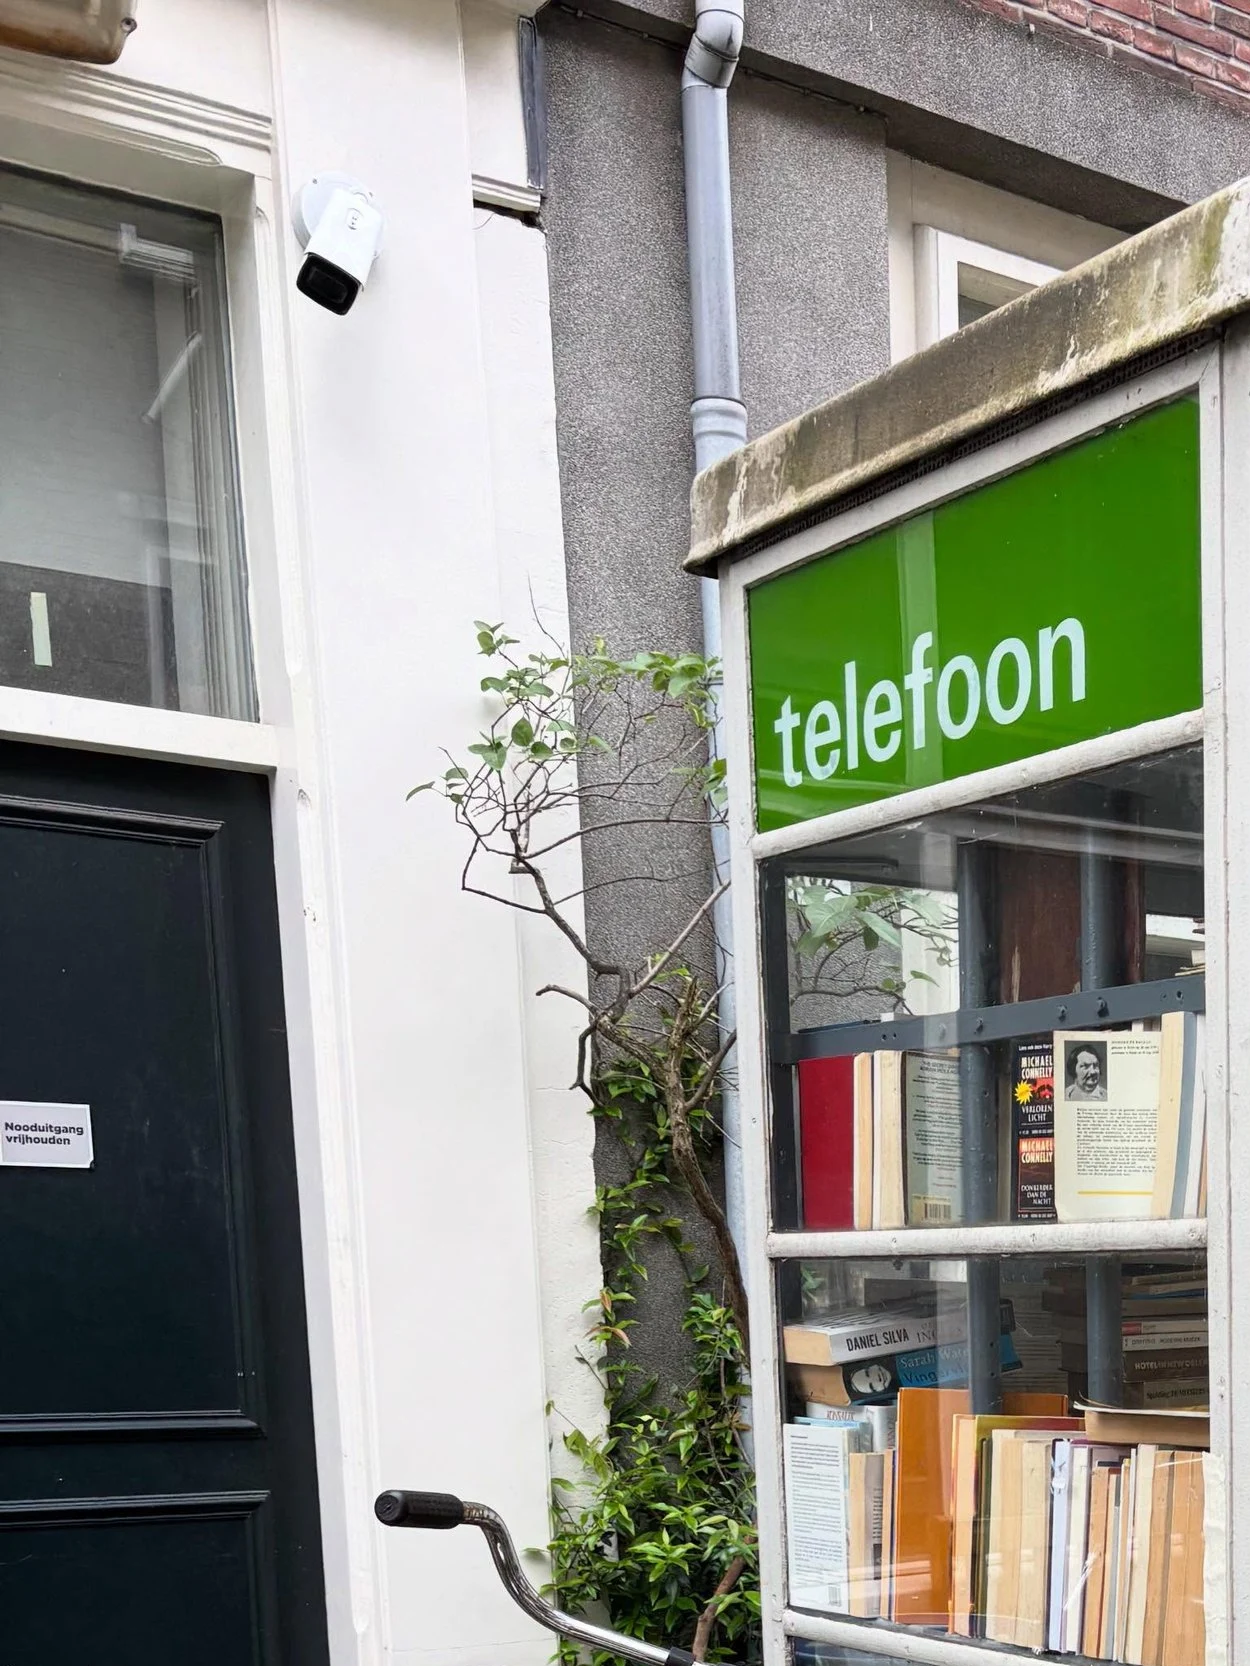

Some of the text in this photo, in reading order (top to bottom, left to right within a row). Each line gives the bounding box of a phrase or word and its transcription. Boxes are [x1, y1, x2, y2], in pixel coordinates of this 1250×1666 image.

[774, 617, 1086, 787] telefoon
[1021, 1055, 1053, 1069] MICHAEL
[1021, 1066, 1053, 1080] CONNELLY
[1021, 1104, 1053, 1114] VERLOREN
[1028, 1112, 1047, 1122] LICHT
[4, 1121, 85, 1137] Nooduitgang
[6, 1133, 72, 1147] vrijhouden
[1021, 1139, 1054, 1152] MICHAEL
[1021, 1150, 1054, 1164] CONNELLY
[846, 1332, 882, 1352] DANIEL
[883, 1327, 910, 1346] SILVA
[900, 1354, 936, 1368] Sarah
